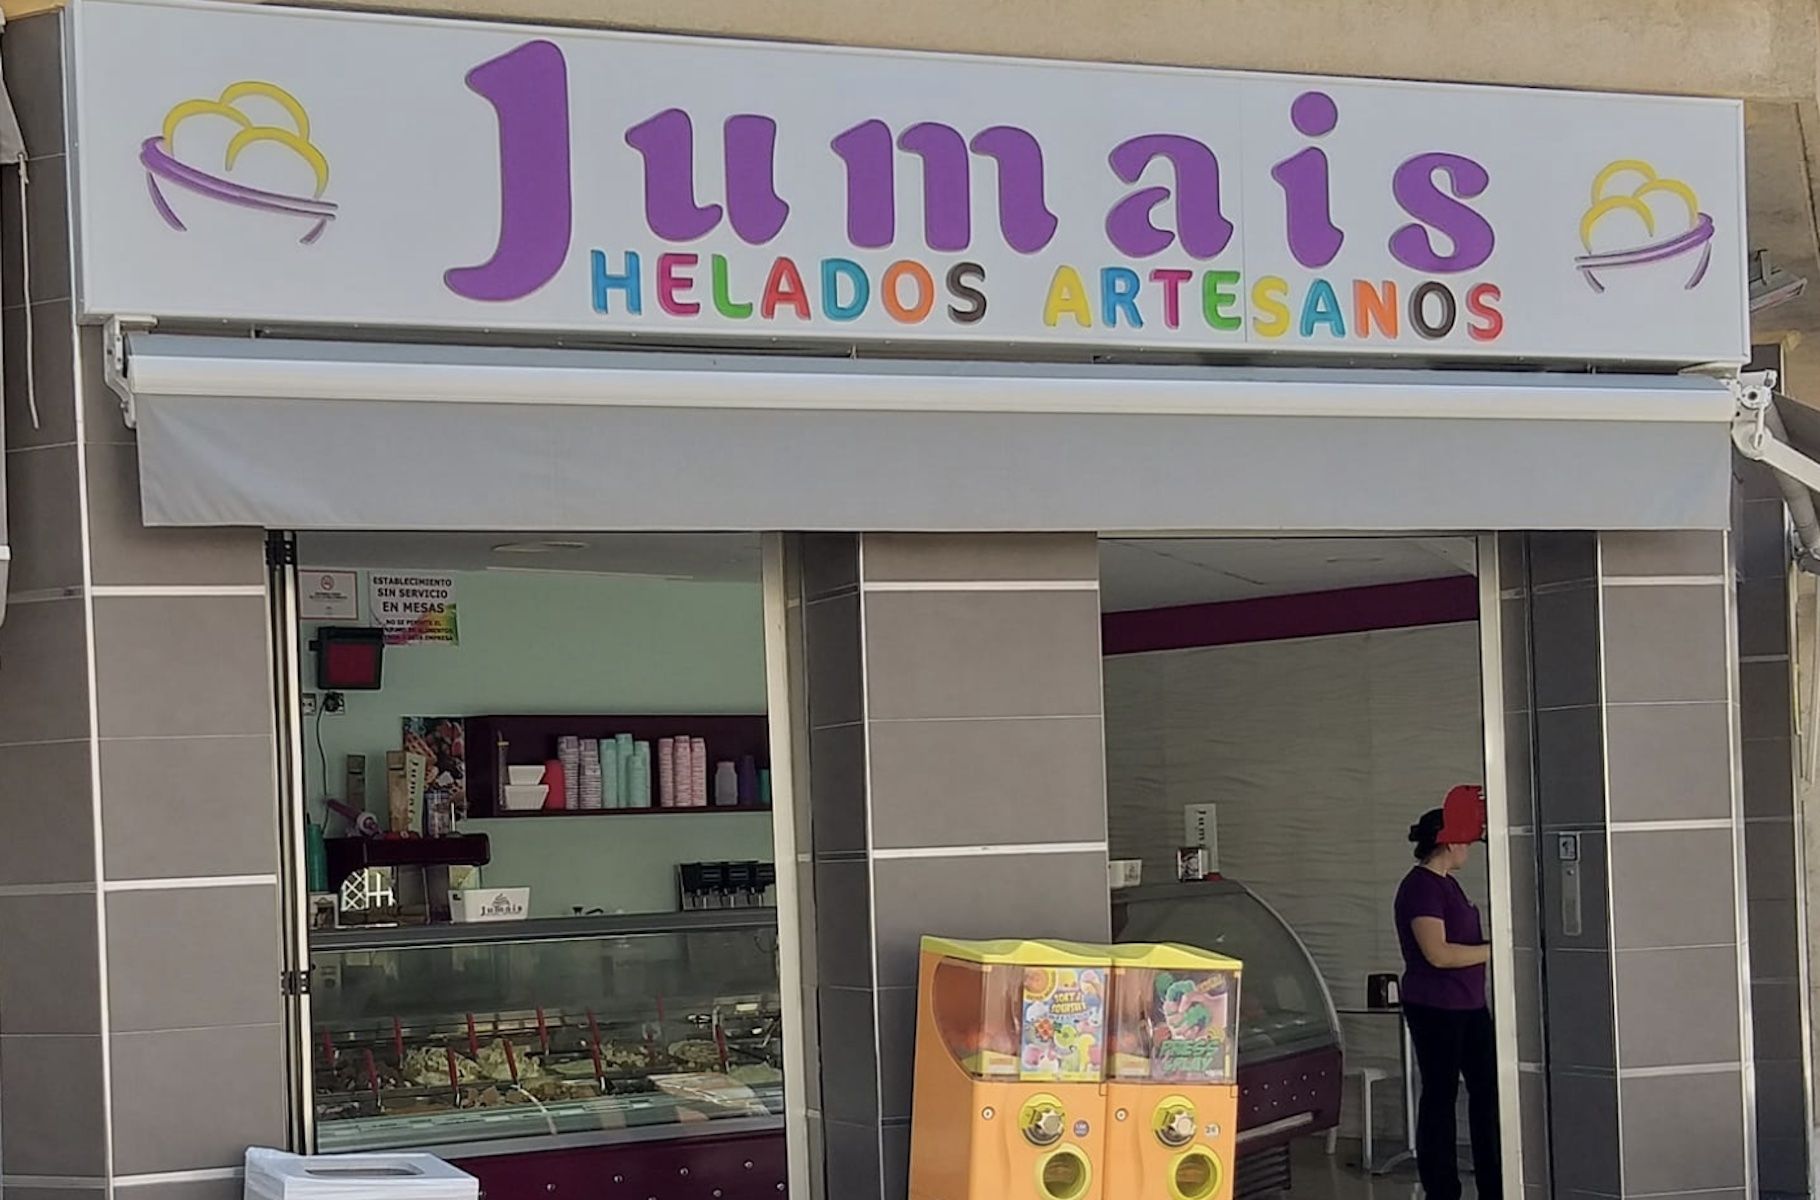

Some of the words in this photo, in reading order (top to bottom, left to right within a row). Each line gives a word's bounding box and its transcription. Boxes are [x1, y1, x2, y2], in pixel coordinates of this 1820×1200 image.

[444, 40, 1497, 303] Jumais
[590, 249, 988, 325] HELADOS
[1043, 264, 1504, 341] ARTESANOS
[373, 577, 452, 587] ESTABLECIMIENTO
[377, 588, 396, 598] SIN
[399, 588, 448, 599] SERVICIO
[382, 601, 399, 612] EN
[403, 602, 444, 613] MESAS
